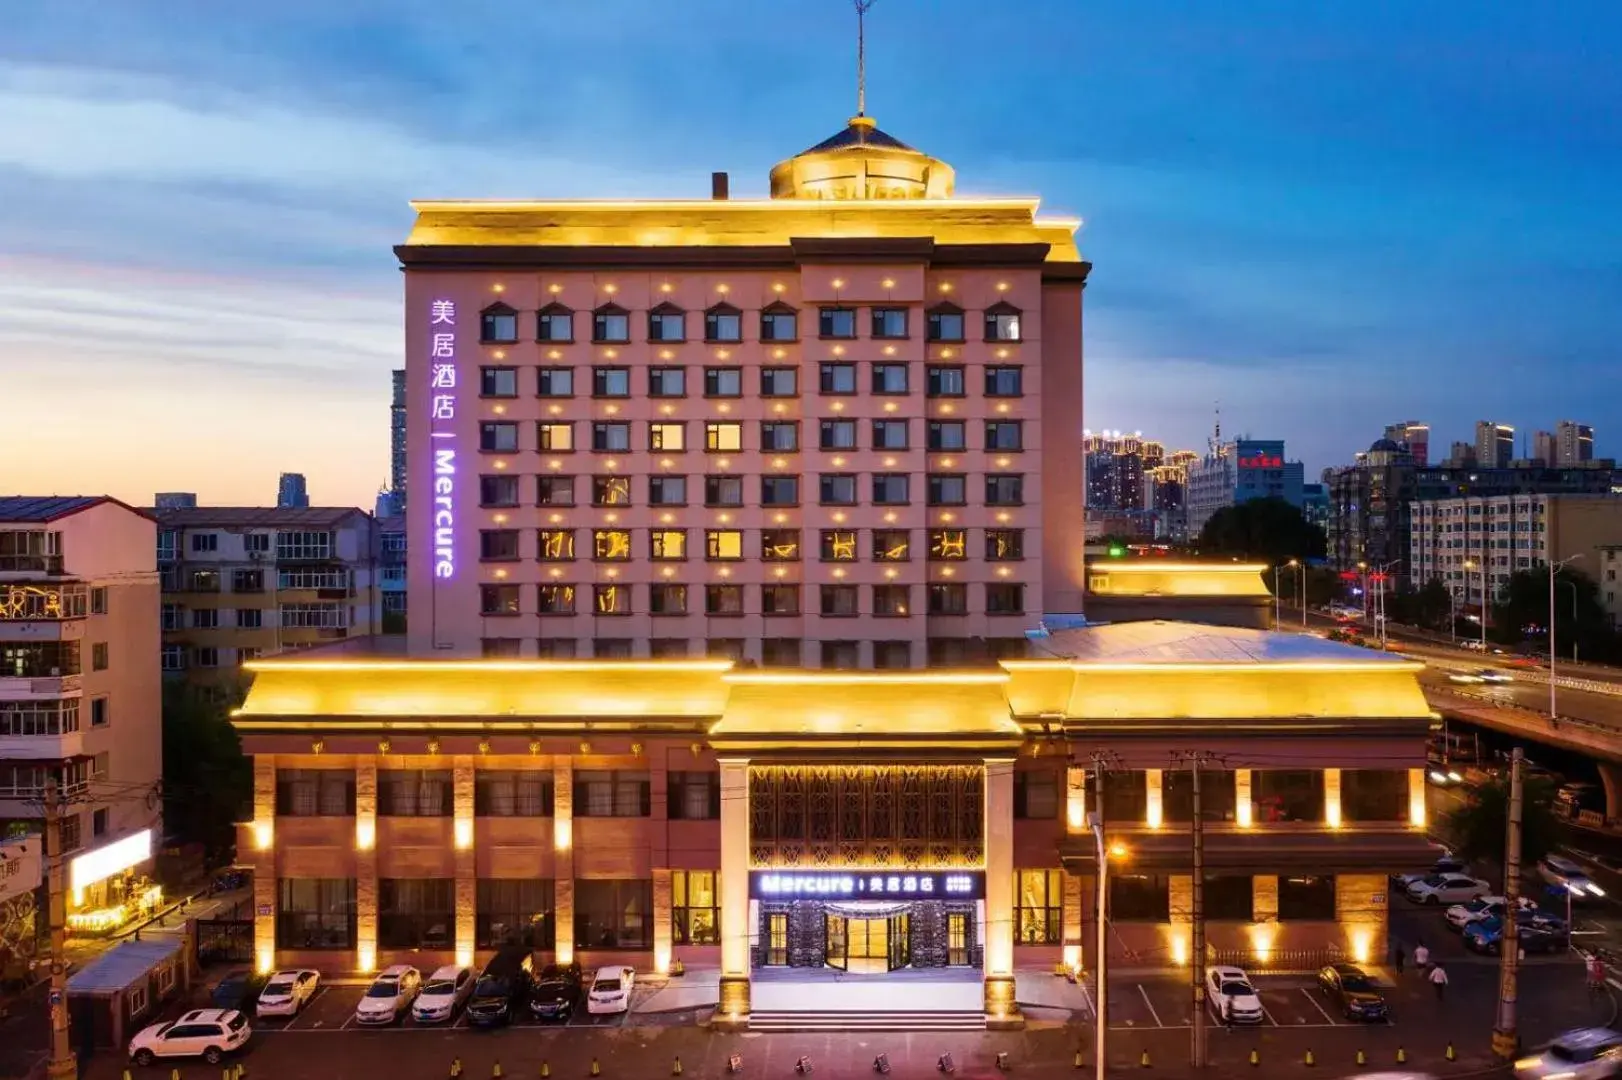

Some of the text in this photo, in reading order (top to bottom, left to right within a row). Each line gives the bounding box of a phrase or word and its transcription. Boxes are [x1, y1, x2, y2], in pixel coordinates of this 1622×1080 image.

[432, 300, 455, 419] 美居酒店
[434, 449, 455, 579] Mercure
[760, 875, 853, 892] Mercure
